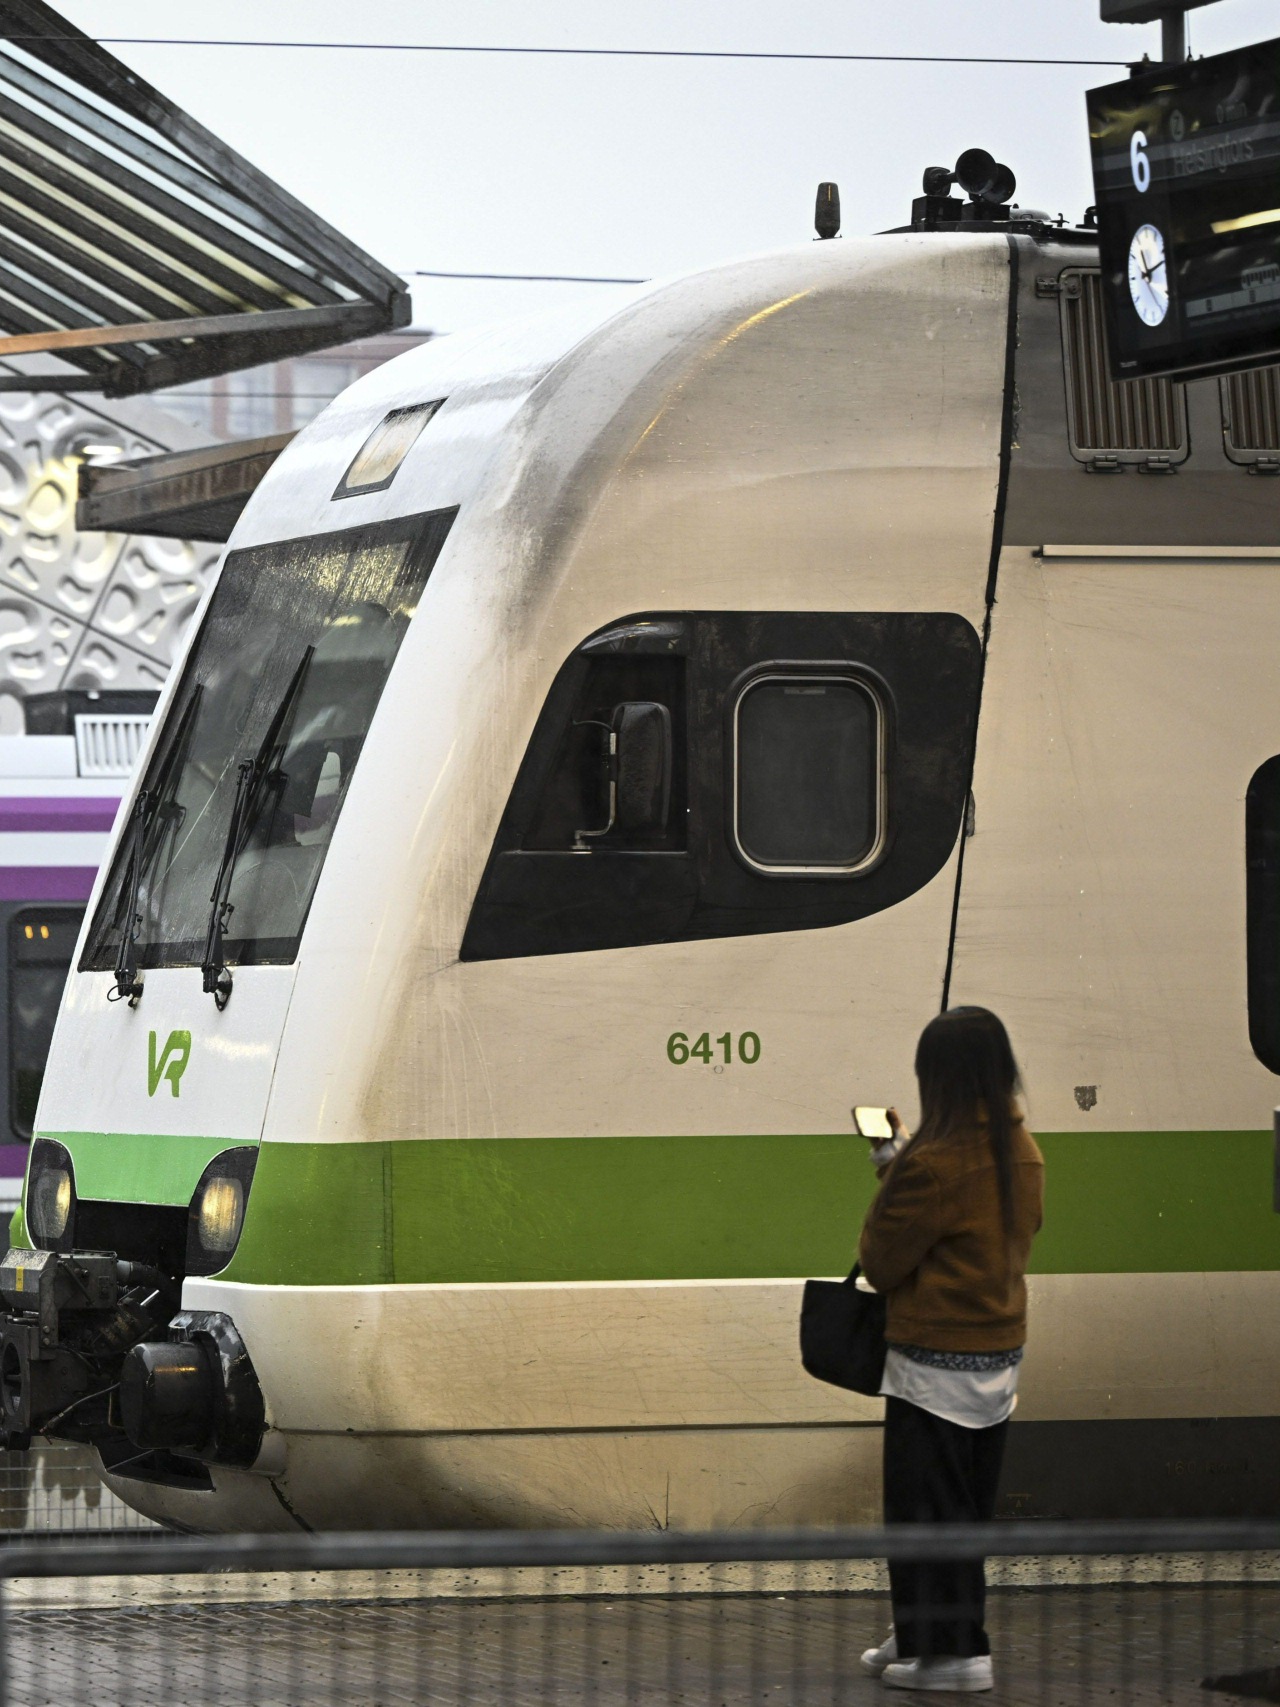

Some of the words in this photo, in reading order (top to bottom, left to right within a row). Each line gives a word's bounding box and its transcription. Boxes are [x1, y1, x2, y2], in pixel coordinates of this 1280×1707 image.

[1130, 130, 1151, 193] 6
[147, 1030, 192, 1098] VR
[667, 1031, 761, 1065] 6410
